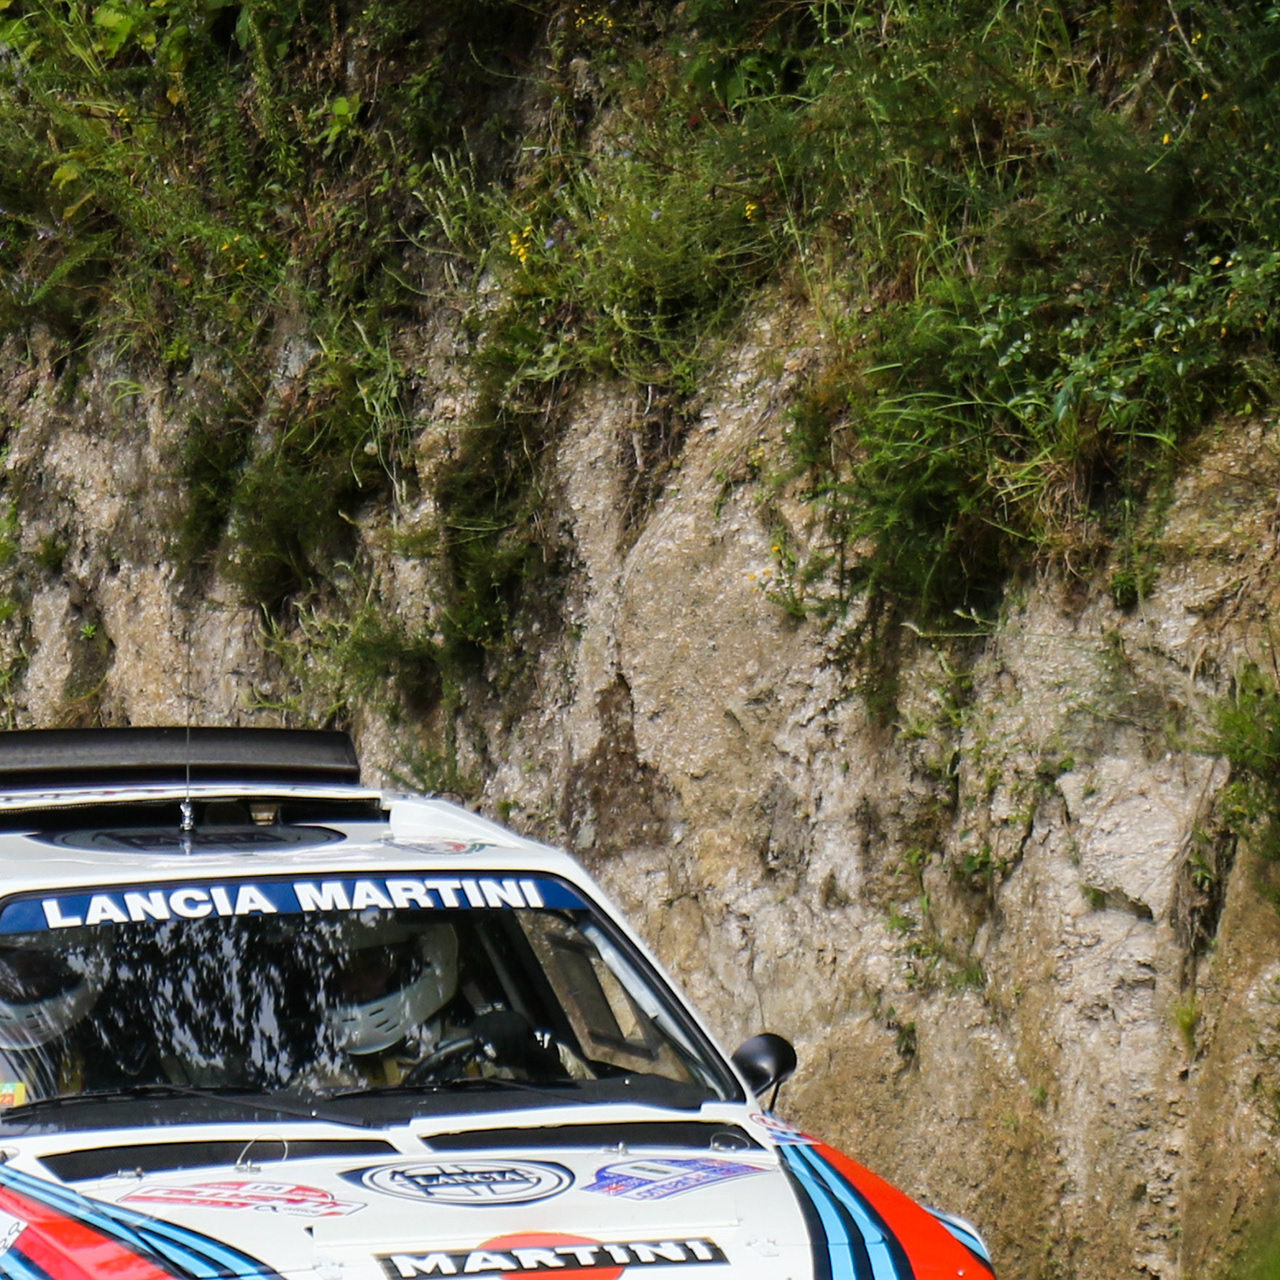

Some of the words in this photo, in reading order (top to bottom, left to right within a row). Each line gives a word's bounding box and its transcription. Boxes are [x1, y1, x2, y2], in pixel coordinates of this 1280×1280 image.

[41, 884, 278, 930] LANCIA
[293, 879, 544, 913] MARTINI
[412, 1170, 524, 1187] LANCIA
[389, 1239, 714, 1279] MARTINI
